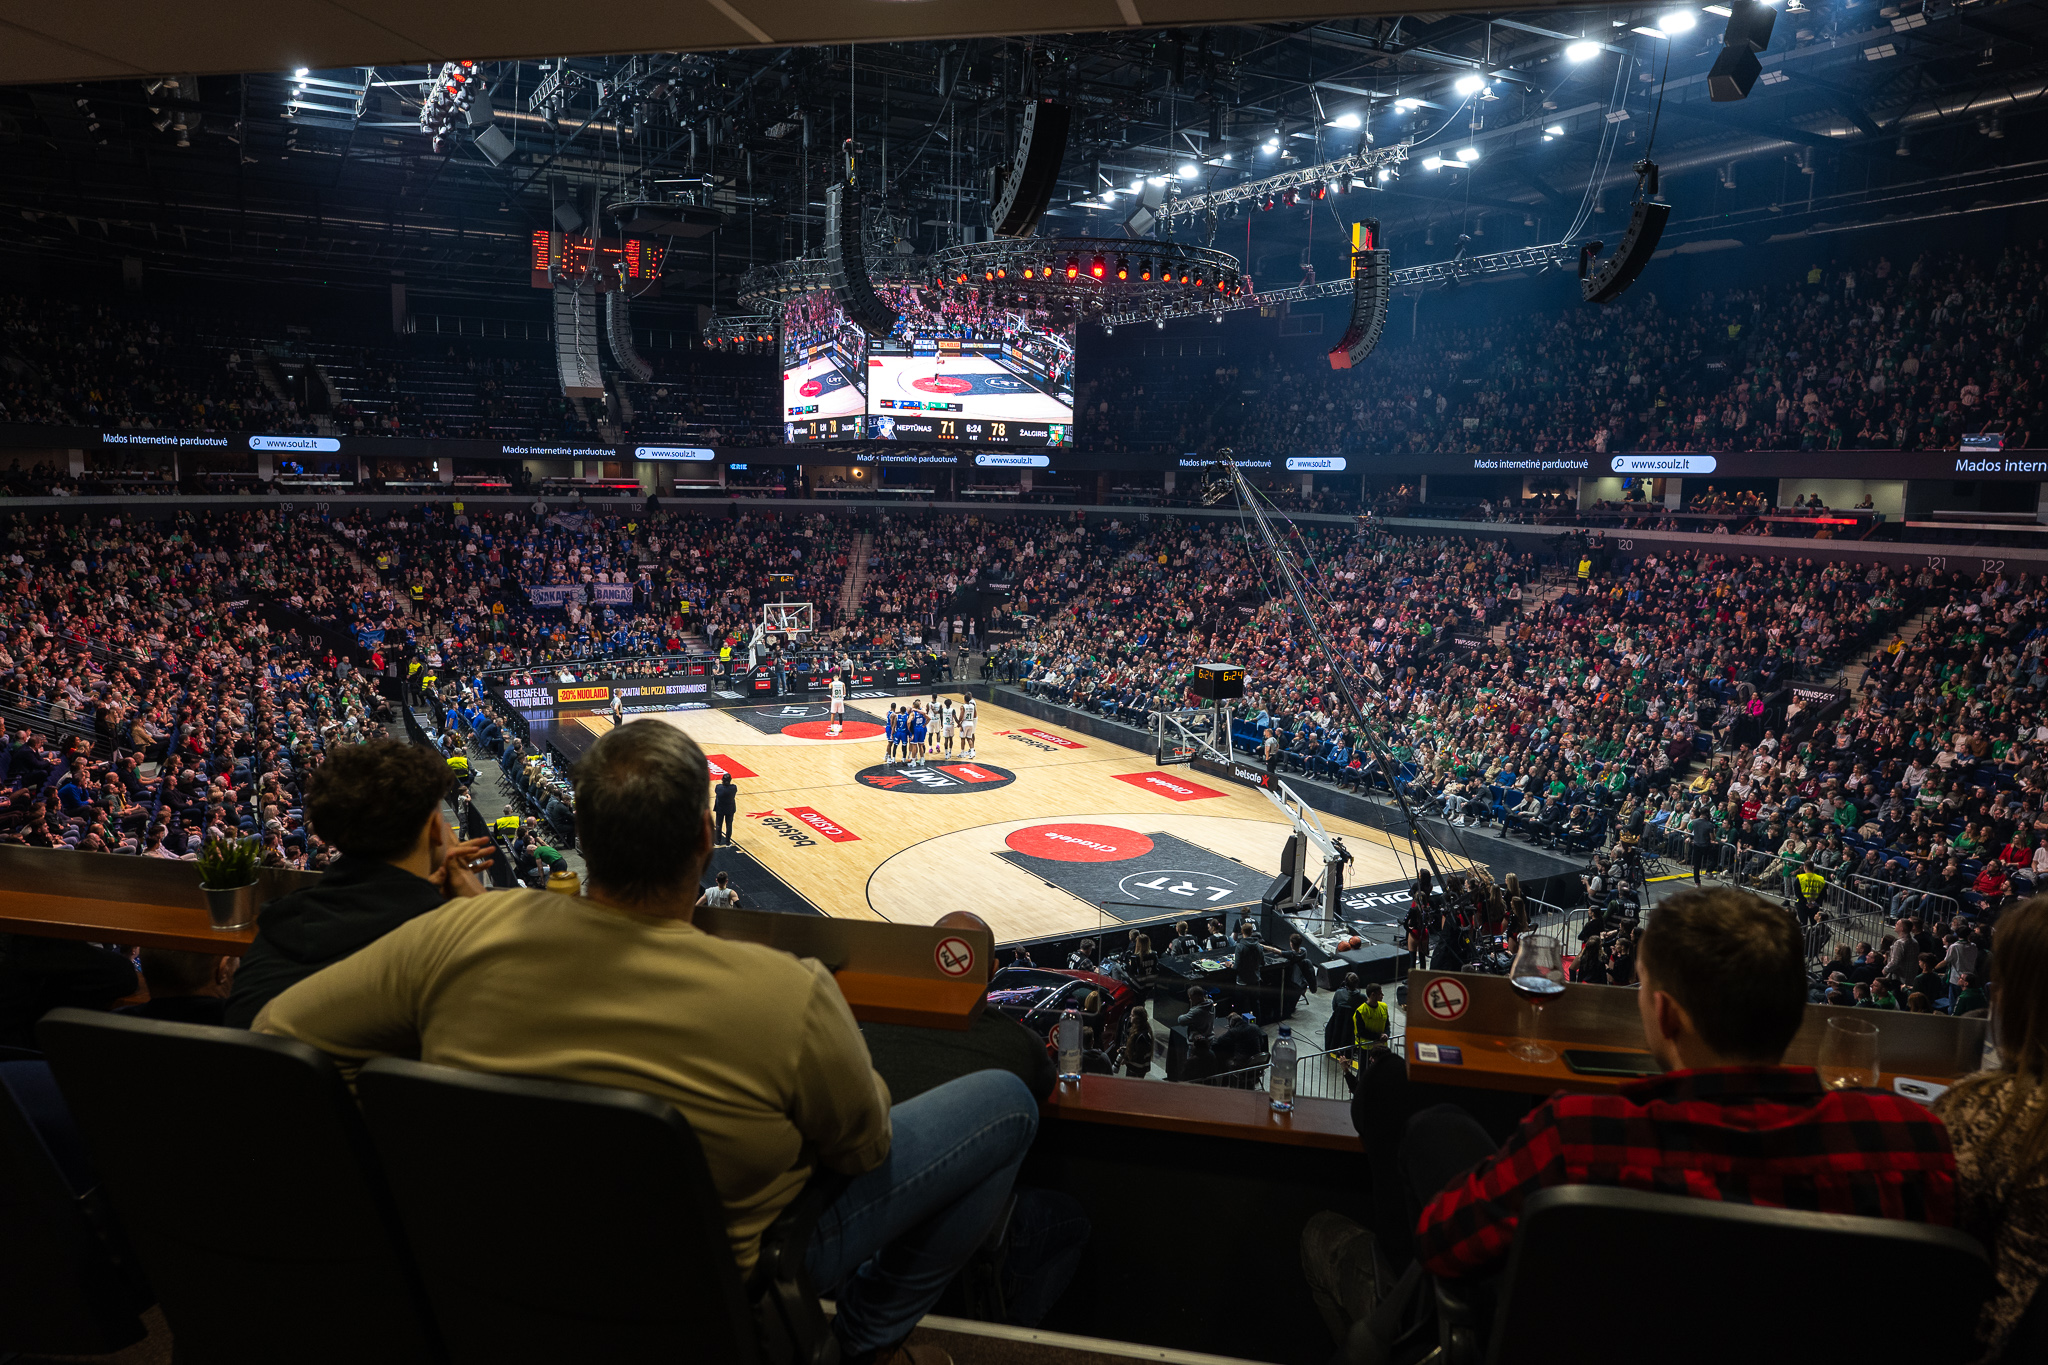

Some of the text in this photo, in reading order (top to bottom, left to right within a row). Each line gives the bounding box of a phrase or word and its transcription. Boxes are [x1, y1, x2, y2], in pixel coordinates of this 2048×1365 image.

[990, 379, 1022, 388] LRT
[810, 422, 816, 434] 71
[830, 420, 837, 433] 78
[896, 424, 932, 432] NEPTŪNAS
[940, 420, 955, 434] 71
[966, 424, 982, 433] 6:24
[991, 422, 1006, 436] 78
[1020, 428, 1048, 437] ŽALGIRIS
[102, 434, 228, 447] Mados internetinė parduotuvė
[266, 439, 318, 448] www.soulz.lt
[502, 446, 616, 457] Mados internetinė parduotuvė
[651, 450, 696, 458] www.soulz.lt
[918, 456, 958, 464] parduotuvė
[1474, 459, 1588, 471] Mados internetinė parduotuvė
[1631, 459, 1690, 469] www.soulz.lt
[1956, 459, 2048, 472] Mados intern
[280, 503, 294, 511] 109
[316, 502, 330, 511] 110
[631, 504, 642, 512] 112
[846, 506, 856, 514] 113
[1586, 538, 1596, 546] 19
[1618, 539, 1633, 550] 120
[1928, 556, 1946, 570] 121
[1982, 559, 2005, 573] 122
[597, 589, 626, 600] BANGA
[1198, 669, 1243, 681] 6:24 6:24
[504, 688, 548, 698] SU BETSAFE-LKL
[560, 688, 608, 700] -20% NUOLAIDA
[613, 684, 707, 698] SSKAITAI ČILI PIZZA RESTORANUOSE!
[896, 770, 957, 788] KMT
[1235, 766, 1262, 784] betsafe
[1146, 777, 1193, 794] Citadele
[801, 813, 842, 834] CASINO
[762, 818, 818, 847] betsafe
[1045, 832, 1117, 852] Citadele
[1134, 876, 1233, 901] LRT
[1340, 892, 1378, 902] agro
